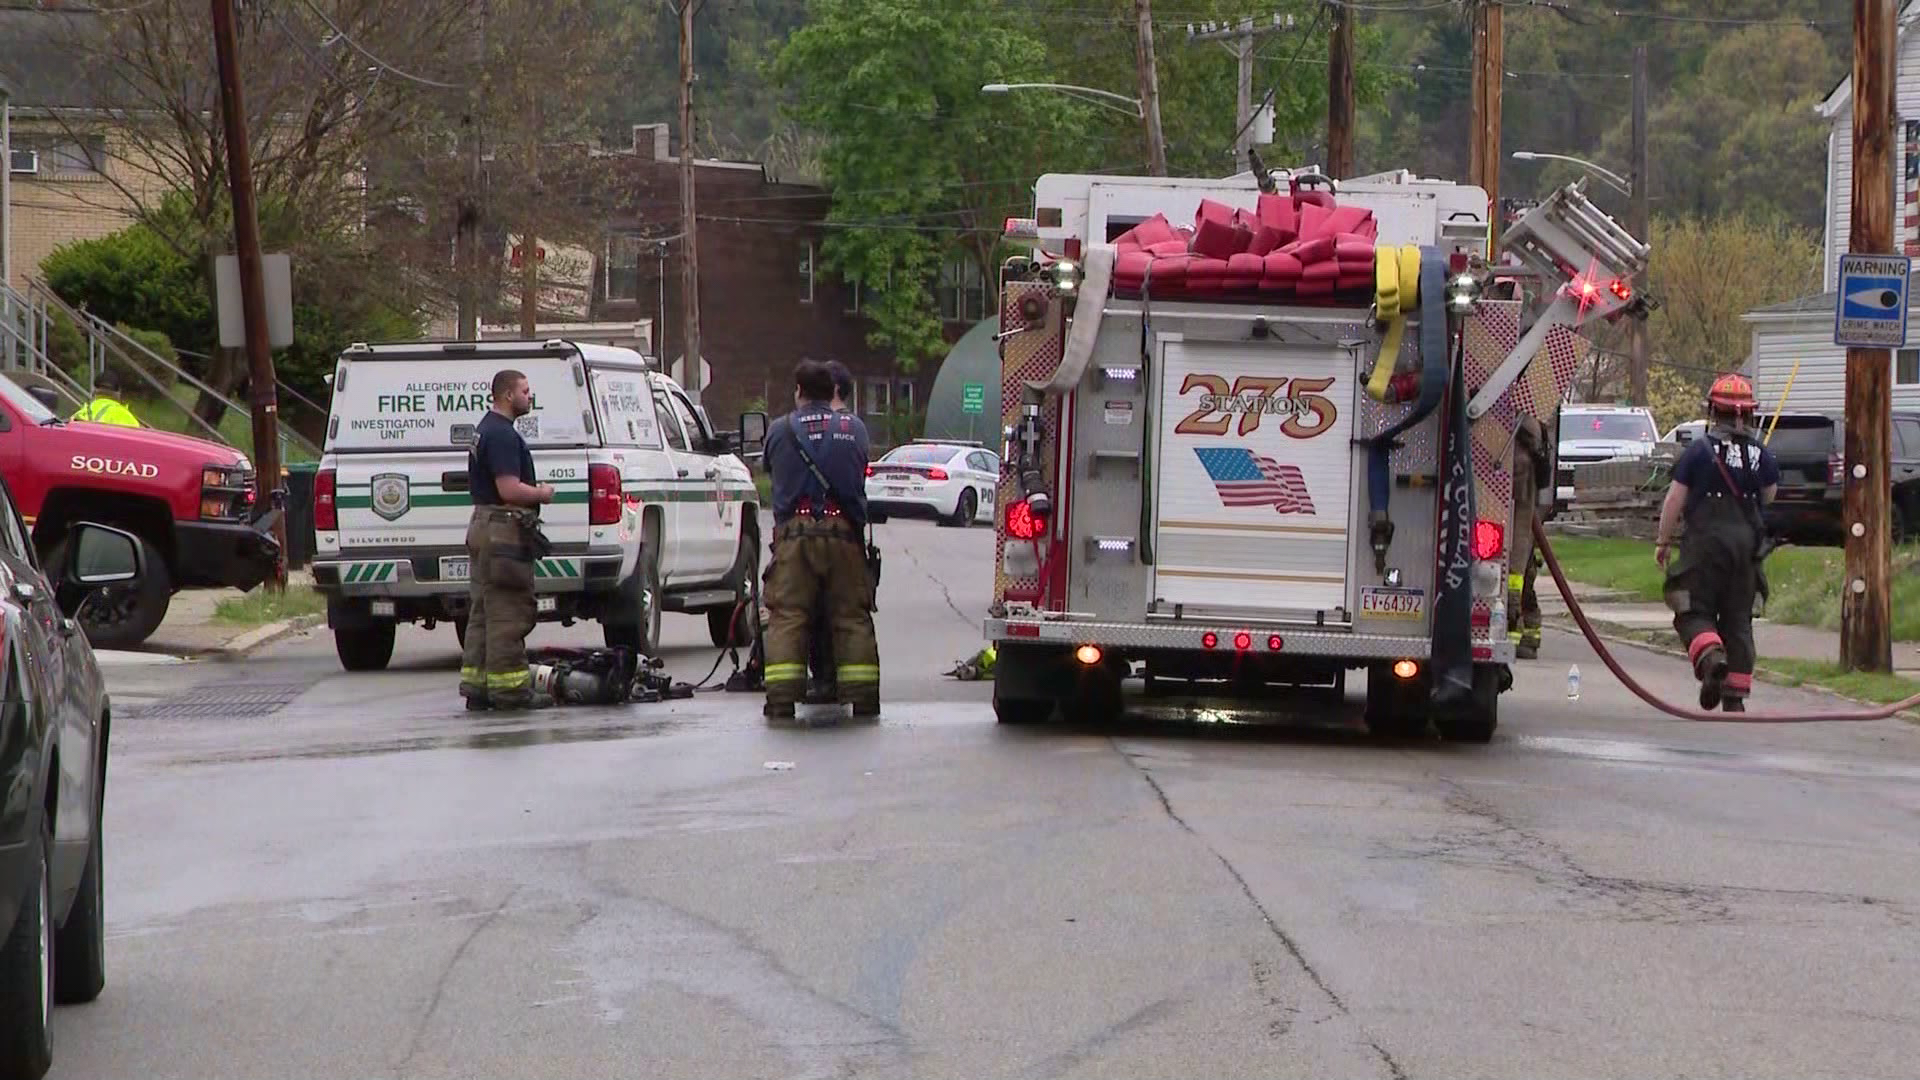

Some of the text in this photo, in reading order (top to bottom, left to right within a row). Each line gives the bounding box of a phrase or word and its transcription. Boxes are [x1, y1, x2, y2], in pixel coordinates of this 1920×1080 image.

[1844, 261, 1906, 275] WARNING
[1842, 320, 1869, 330] CRIME
[406, 382, 467, 392] ALLEGHENY
[378, 395, 426, 412] FIRE
[1174, 373, 1337, 439] 275
[1199, 394, 1312, 416] STATION
[351, 419, 435, 429] INVESTIGATION
[380, 430, 406, 440] UNIT
[71, 456, 159, 478] SQUAD
[549, 469, 575, 478] 4013
